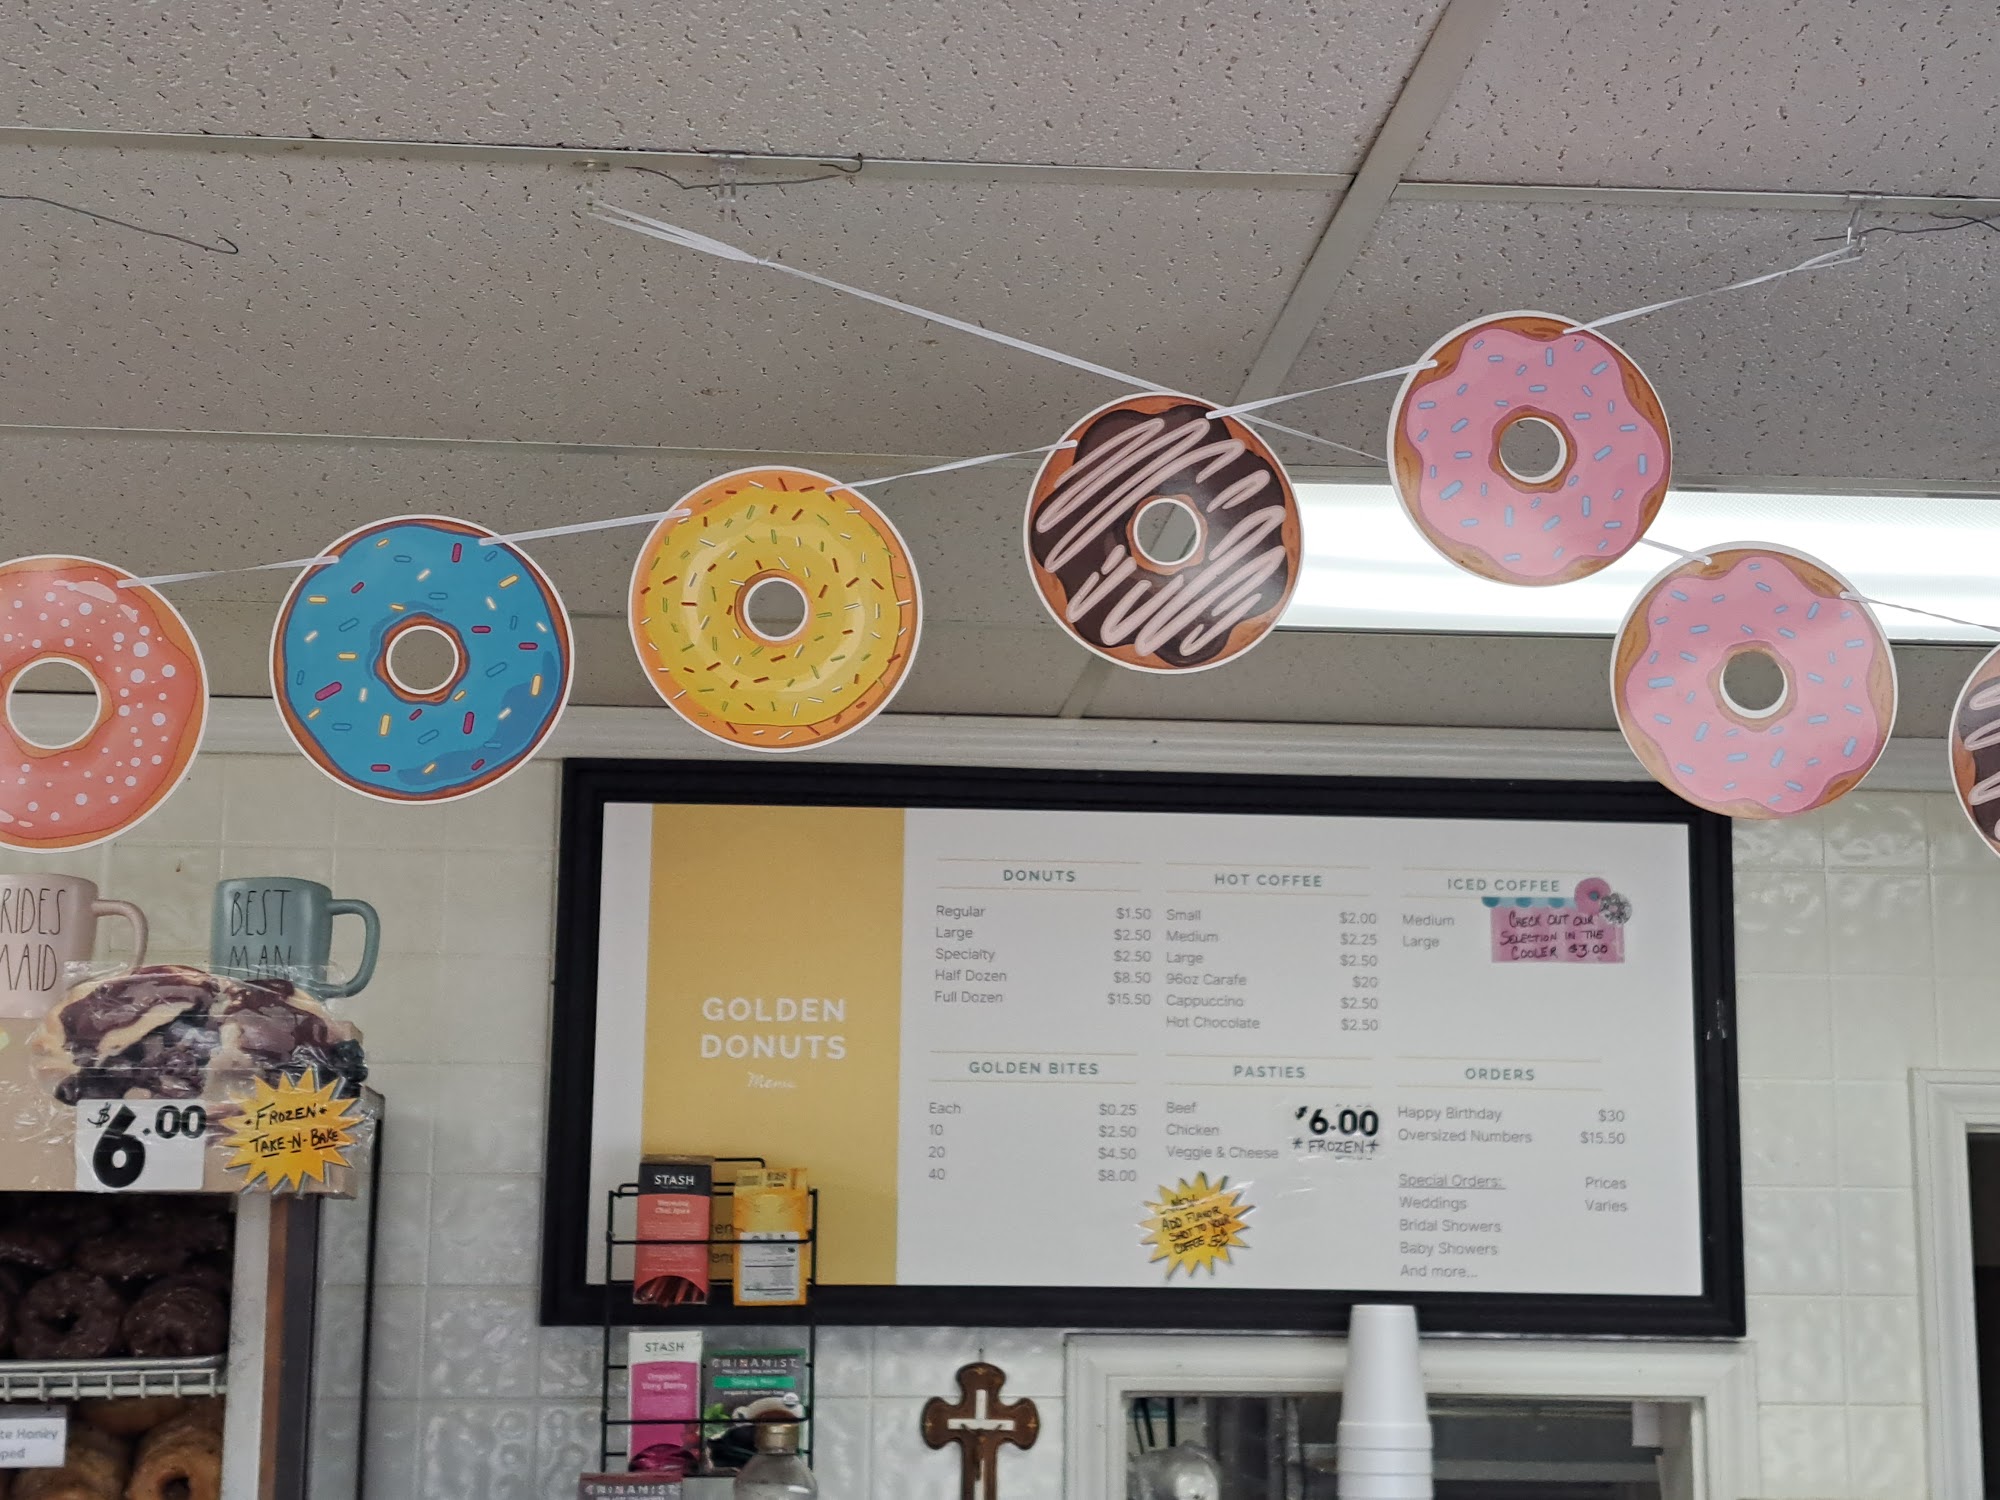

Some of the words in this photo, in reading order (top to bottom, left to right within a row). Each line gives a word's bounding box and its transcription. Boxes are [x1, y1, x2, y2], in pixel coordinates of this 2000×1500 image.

[1003, 870, 1076, 882] DONUTS
[1214, 873, 1250, 885] HOT
[1256, 874, 1322, 887] COFFEE
[1448, 878, 1488, 891] ICED
[1494, 879, 1559, 892] COFFEE
[231, 889, 292, 936] BEST
[936, 905, 986, 920] Regular
[1116, 907, 1152, 920] $1.50
[1166, 909, 1201, 921] Small
[1339, 912, 1377, 924] $2.00
[1401, 913, 1455, 926] Medium
[1546, 914, 1570, 926] OUT
[1573, 914, 1594, 926] OUR
[936, 927, 974, 941] Large
[1114, 928, 1151, 942] $2.50
[1166, 930, 1219, 943] Medium
[1340, 932, 1378, 946] $2.25
[1500, 930, 1557, 945] SELECTION
[1565, 931, 1575, 941] IN
[1583, 930, 1604, 941] THE
[1403, 936, 1440, 951] Large
[936, 947, 996, 963] Specialty
[1113, 949, 1152, 962] $2.50
[1166, 952, 1204, 966] Large
[1511, 946, 1558, 960] COOLER
[1568, 944, 1608, 958] $3.00
[228, 944, 292, 980] MAN
[1340, 953, 1378, 968] $2.50
[935, 969, 962, 981] Half
[966, 969, 1007, 982] Dozen
[1113, 970, 1152, 984] $8.50
[1166, 973, 1199, 985] 96oz
[1202, 973, 1247, 985] Carafe
[1352, 974, 1380, 989] $20
[934, 990, 957, 1003] Full
[961, 991, 1003, 1003] Dozen
[1107, 992, 1152, 1005] $15.50
[1165, 994, 1246, 1009] Cappuccino
[1340, 996, 1379, 1009] $2.50
[702, 997, 845, 1022] GOLDEN
[1166, 1016, 1190, 1028] Hot
[1192, 1015, 1261, 1029] Chocolate
[1341, 1017, 1378, 1031] $2.50
[701, 1034, 846, 1060] DONUTS
[968, 1061, 1041, 1074] GOLDEN
[1048, 1062, 1099, 1075] BITES
[1233, 1065, 1305, 1079] PASTIES
[1464, 1068, 1534, 1081] ORDERS
[747, 1071, 797, 1089] Menu
[928, 1102, 961, 1114] Each
[1099, 1102, 1137, 1116] $0.25
[1166, 1101, 1198, 1114] Beef
[1398, 1106, 1442, 1122] Happy
[1446, 1106, 1502, 1123] Birthday
[254, 1104, 317, 1129] FROZEN
[1295, 1106, 1378, 1136] $6.00
[1598, 1108, 1625, 1123] $30
[929, 1124, 944, 1136] 10
[1098, 1124, 1138, 1138] $2.50
[1166, 1123, 1220, 1136] Chicken
[1398, 1128, 1467, 1142] Oversized
[1470, 1130, 1533, 1143] Numbers
[1580, 1131, 1626, 1144] $15.50
[87, 1102, 207, 1188] $6.00
[928, 1146, 946, 1158] 20
[1309, 1140, 1364, 1153] FROZEN
[1098, 1147, 1136, 1160] $4.50
[1166, 1145, 1213, 1160] Veggie
[1215, 1146, 1226, 1158] &
[1228, 1146, 1280, 1159] Cheese
[654, 1175, 694, 1186] STASH
[928, 1168, 945, 1180] 40
[1098, 1169, 1137, 1182] $8.00
[1399, 1174, 1447, 1187] Special
[1585, 1176, 1627, 1189] Prices
[1399, 1195, 1468, 1212] Weddings
[1585, 1200, 1628, 1212] Varies
[1399, 1218, 1438, 1232] Bridal
[1442, 1219, 1502, 1232] Showers
[1400, 1241, 1434, 1258] Baby
[1438, 1241, 1499, 1256] Showers
[1400, 1264, 1428, 1277] And
[645, 1342, 684, 1352] STASH
